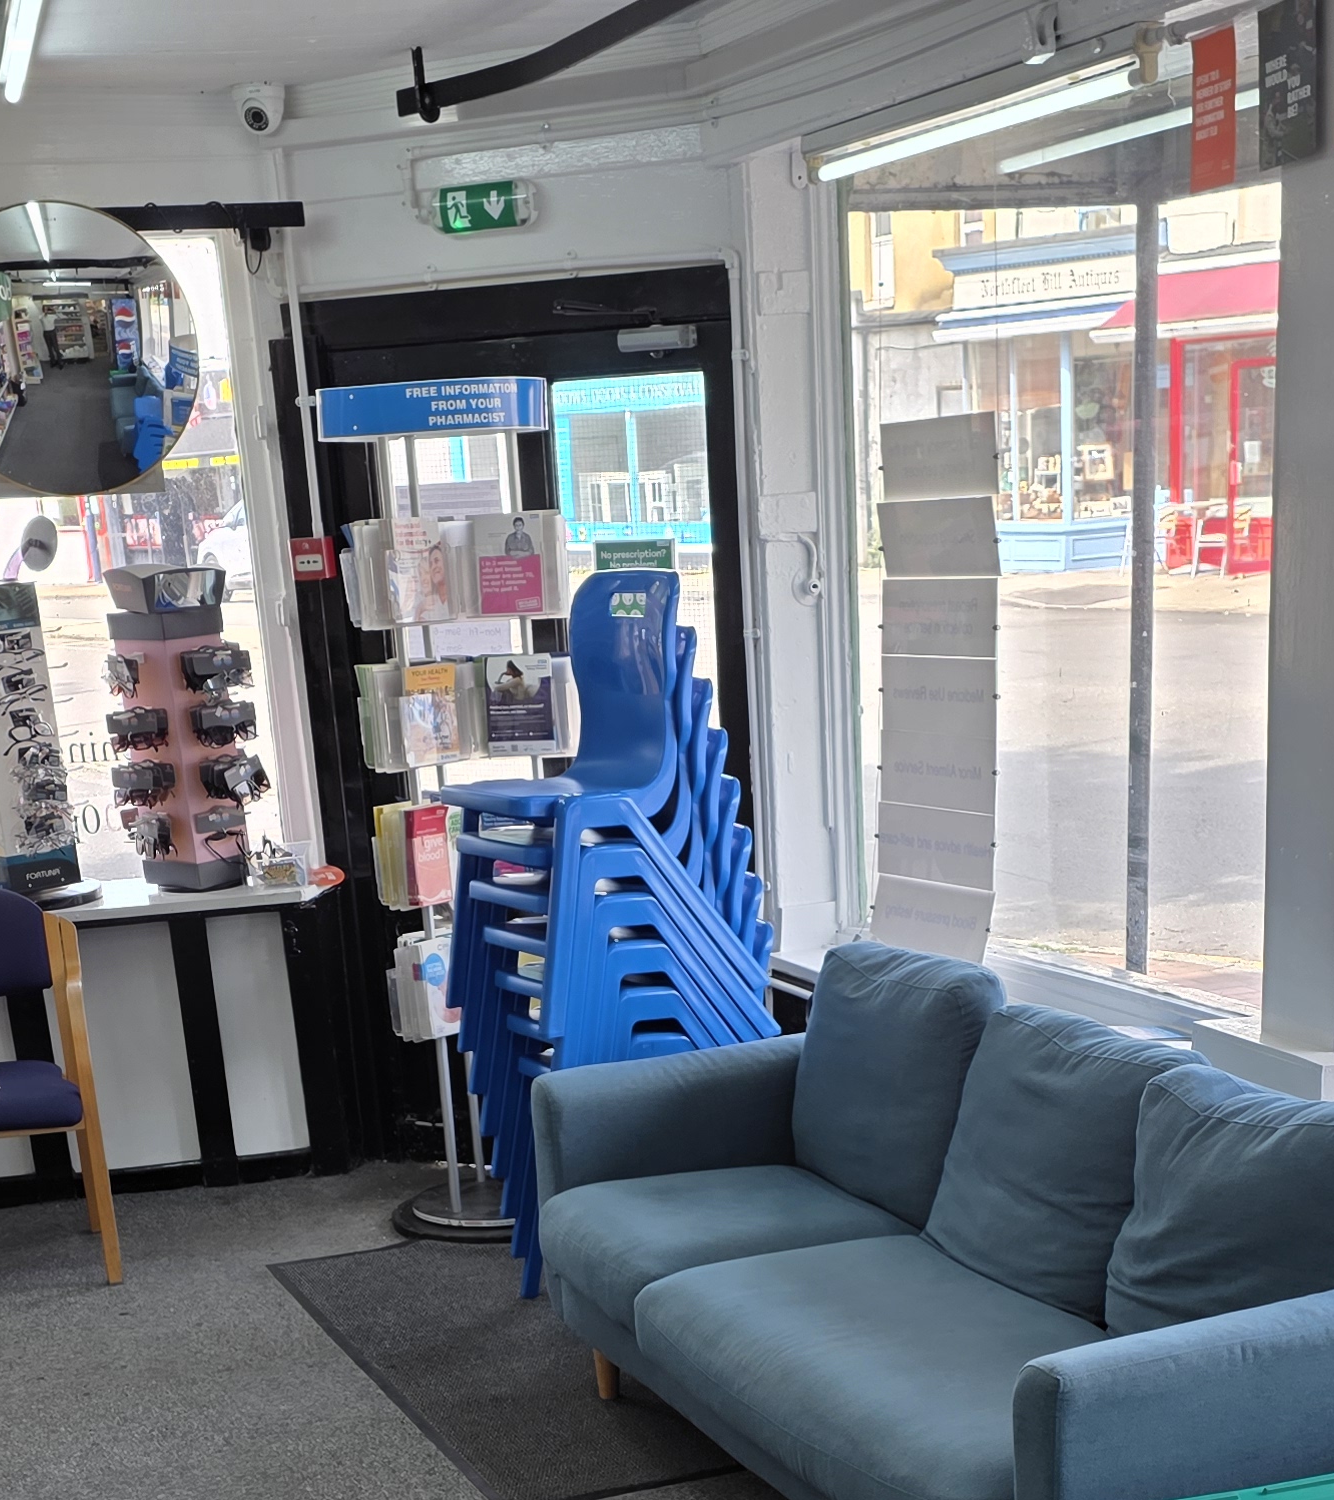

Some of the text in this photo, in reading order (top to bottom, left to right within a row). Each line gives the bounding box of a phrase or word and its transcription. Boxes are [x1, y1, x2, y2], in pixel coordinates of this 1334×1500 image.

[1265, 54, 1287, 74] WHERE
[1265, 70, 1288, 88] WOULD
[1287, 75, 1301, 89] YOU
[1287, 85, 1312, 104] RATHER
[1287, 103, 1299, 119] BE?
[1069, 269, 1119, 290] Antiques
[406, 383, 518, 398] FREE INFORMATION
[431, 398, 502, 411] FROM YOUR
[428, 412, 505, 426] PHARMACIST
[600, 548, 666, 562] No prescription?
[411, 668, 449, 677] YOUR HEALTH
[424, 837, 445, 851] give
[418, 848, 444, 863] blood?
[26, 867, 61, 881] FORTUNA
